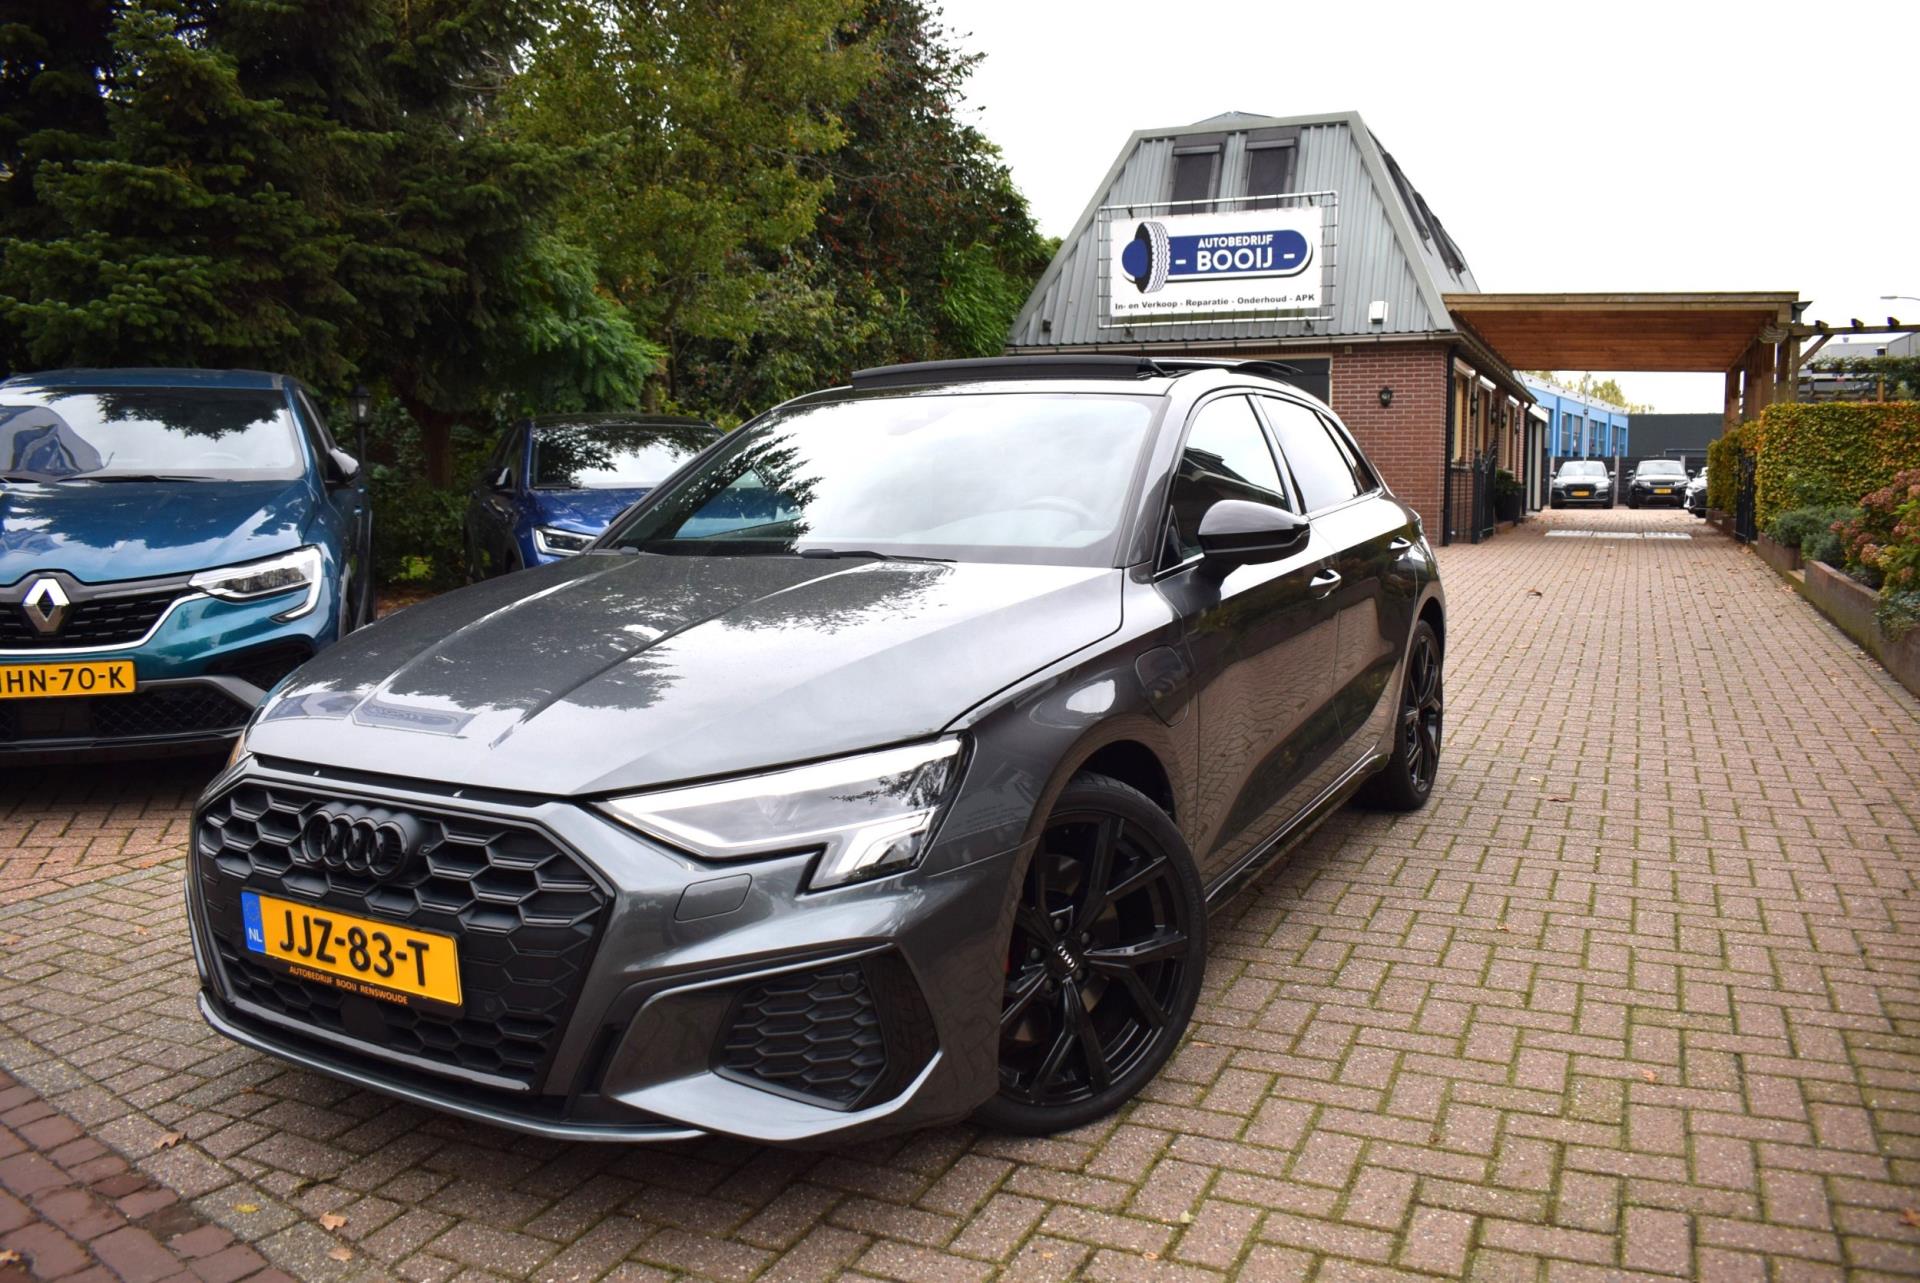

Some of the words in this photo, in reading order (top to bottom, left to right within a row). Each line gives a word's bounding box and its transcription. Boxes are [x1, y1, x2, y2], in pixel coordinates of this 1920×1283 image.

[1198, 234, 1273, 248] AUTOBEDRIJF
[1197, 247, 1273, 271] BOOIJ
[1115, 302, 1127, 310] In-
[1142, 299, 1178, 310] Verkoop
[1185, 297, 1229, 308] Reparatie
[1237, 295, 1287, 304] Onderhoud
[1295, 294, 1315, 302] APK
[0, 666, 126, 693] HN-70-K
[249, 927, 263, 943] NL
[279, 909, 430, 987] JJZ-83-T
[289, 965, 333, 985] AUTOBEDRIJF
[360, 984, 408, 1005] RENSWOUDE
